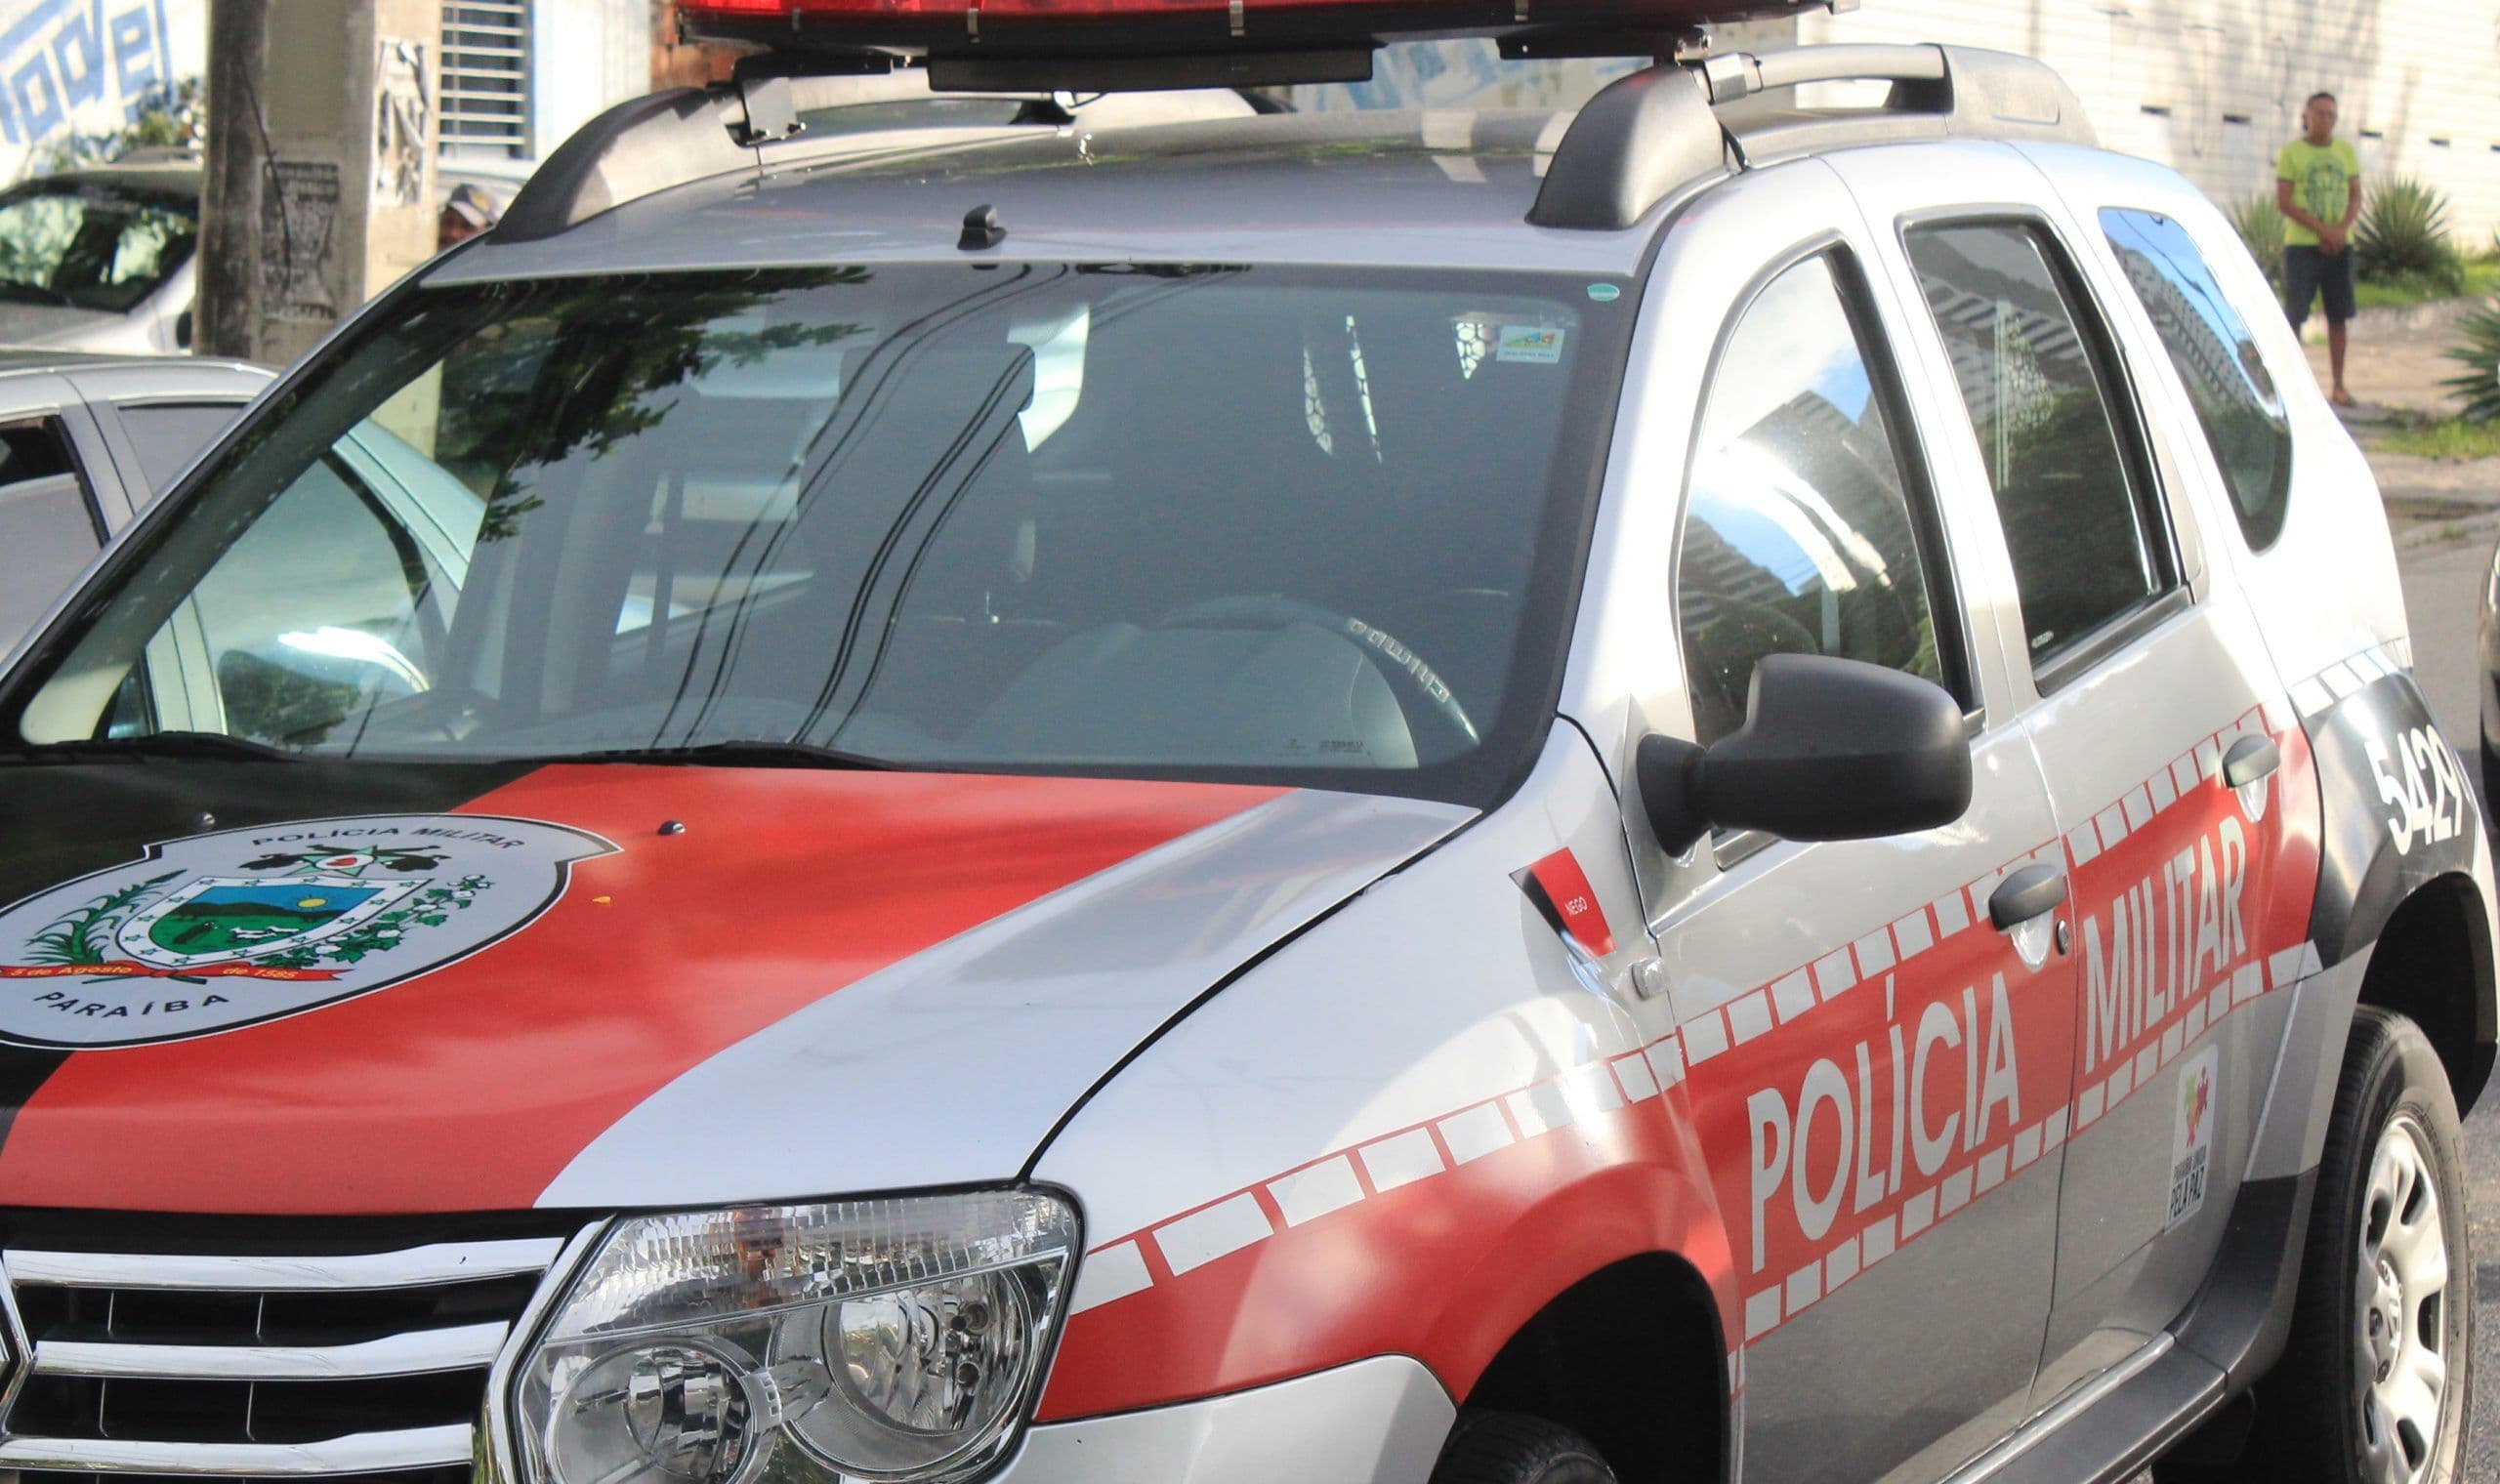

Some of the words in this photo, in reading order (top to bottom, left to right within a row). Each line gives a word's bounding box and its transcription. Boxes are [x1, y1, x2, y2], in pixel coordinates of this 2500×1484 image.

[2364, 723, 2462, 855] 5429
[409, 828, 524, 848] MILITAR
[1747, 972, 2020, 1273] POLÍCIA
[2083, 814, 2246, 1075] MILITAR
[2188, 1164, 2205, 1208] PAZ
